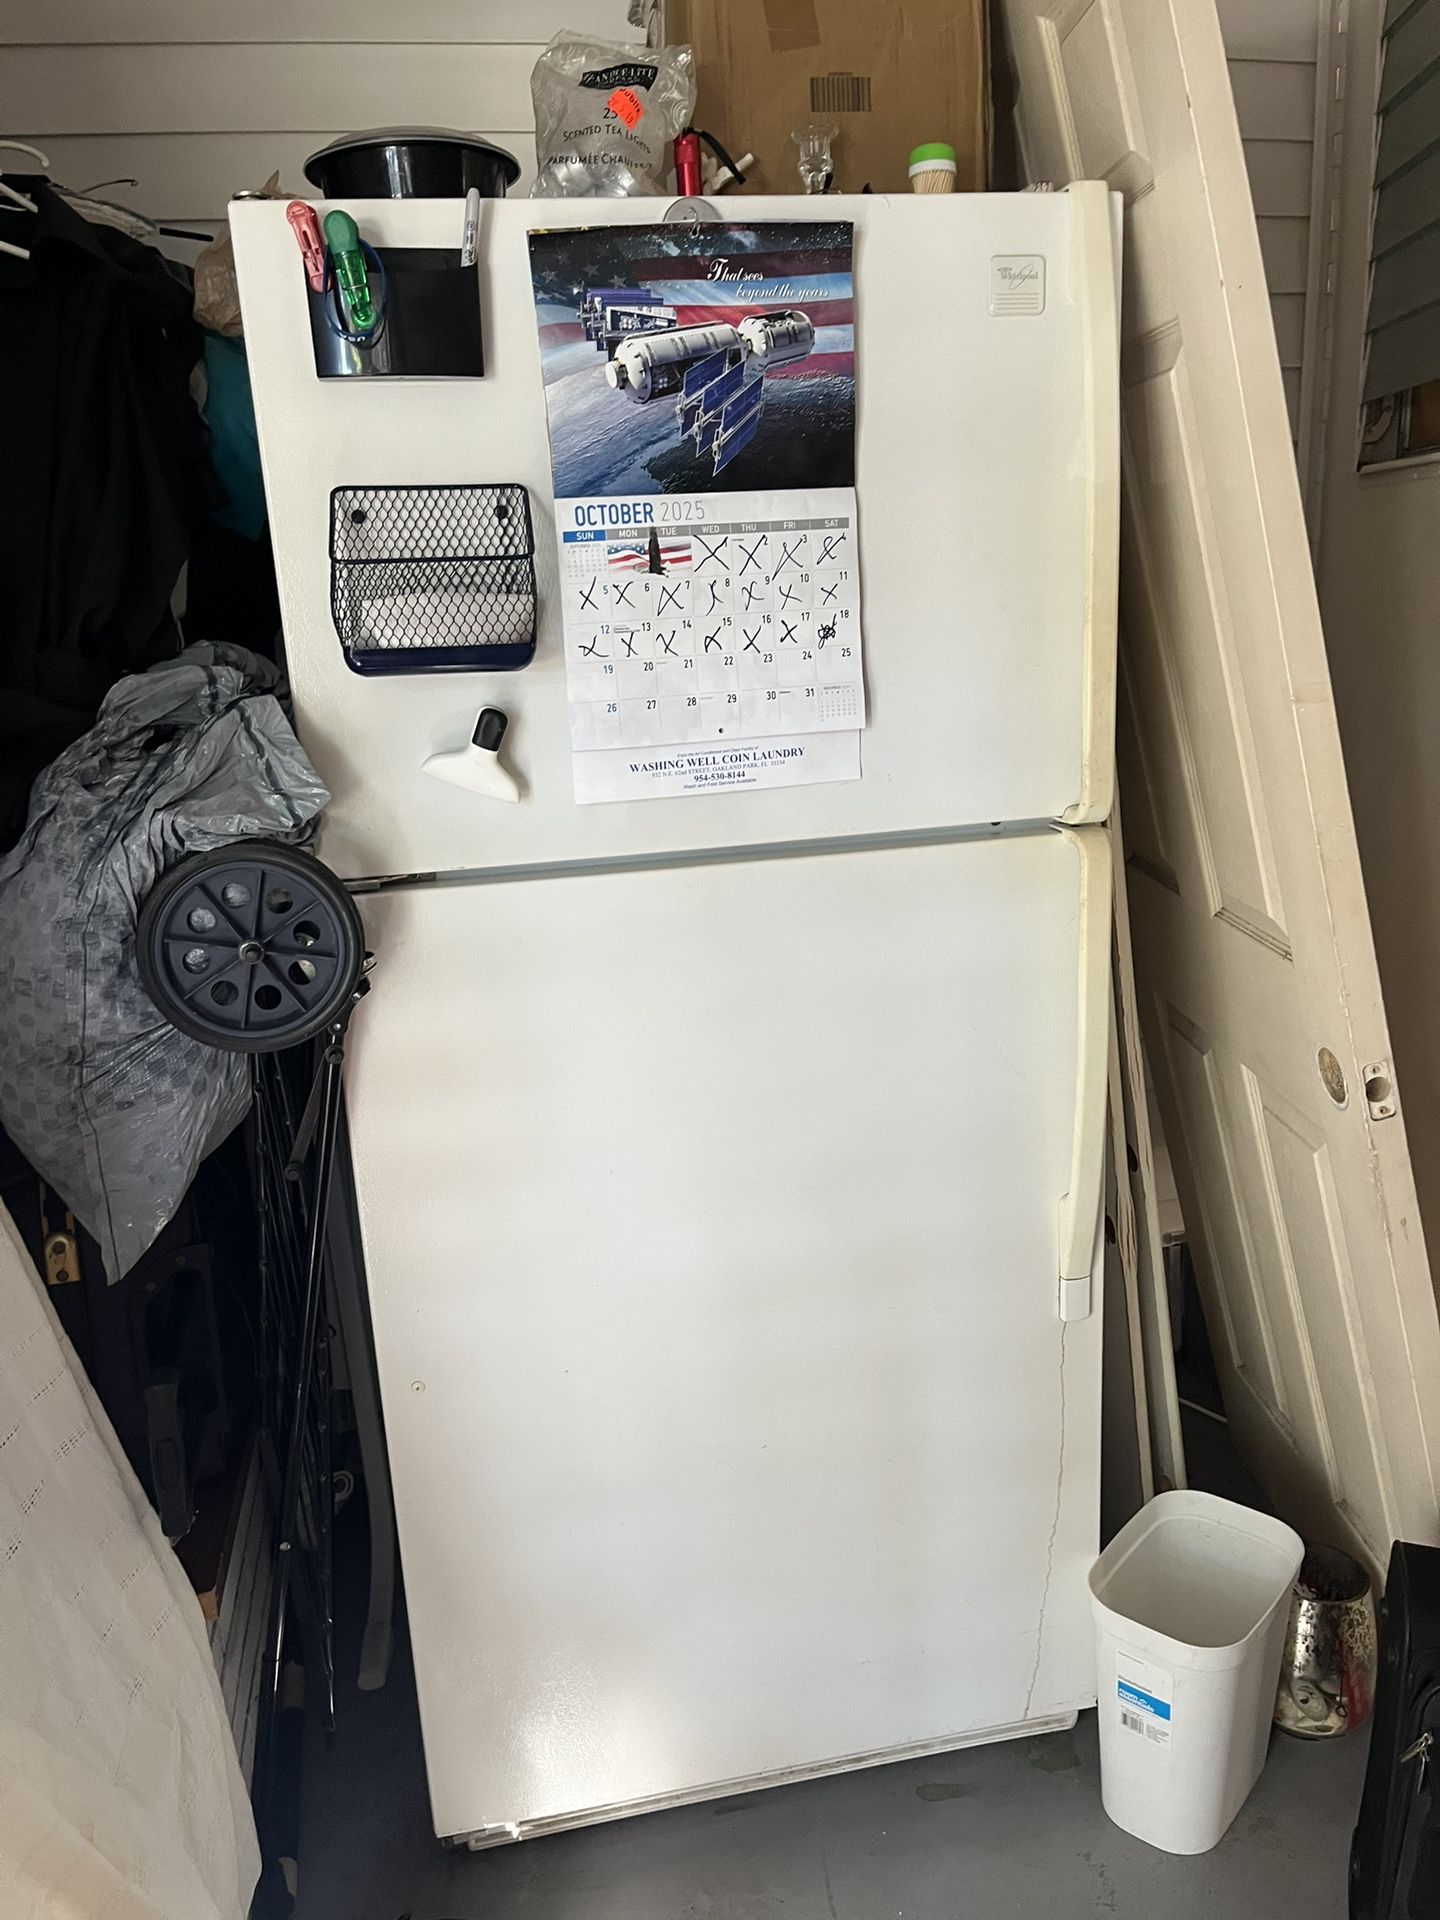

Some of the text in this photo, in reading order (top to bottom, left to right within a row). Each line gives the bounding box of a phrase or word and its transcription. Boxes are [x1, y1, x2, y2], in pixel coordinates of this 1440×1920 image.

[563, 125, 601, 142] SCENTED
[605, 124, 622, 136] TEA
[707, 258, 764, 282] That sees
[736, 283, 829, 304] beyond the years
[574, 500, 705, 527] OCTOBER 2025
[576, 519, 839, 541] SUN MON TUE WED THU FRI SAT
[801, 534, 807, 544] 3
[603, 571, 848, 595] 5 6 7 8 9 10 11
[600, 625, 610, 634] 12
[642, 622, 651, 631] 13
[682, 620, 692, 629] 14
[722, 617, 732, 627] 15
[762, 614, 771, 624] 16
[801, 612, 810, 621] 17
[840, 609, 849, 618] 18
[603, 665, 613, 674] 19
[644, 662, 653, 671] 20
[684, 659, 693, 668] 21
[724, 656, 733, 665] 22
[763, 654, 773, 663] 23
[803, 651, 812, 660] 24
[841, 648, 851, 657] 25
[607, 704, 617, 712] 26
[647, 700, 656, 709] 27
[687, 697, 697, 706] 28
[727, 694, 737, 703] 29
[766, 691, 776, 700] 30
[805, 688, 814, 697] 31
[629, 747, 805, 773] WASHING WELL COIN LAUNDRY
[712, 763, 742, 772] OAKLAND
[694, 770, 745, 782] 954-530-8144
